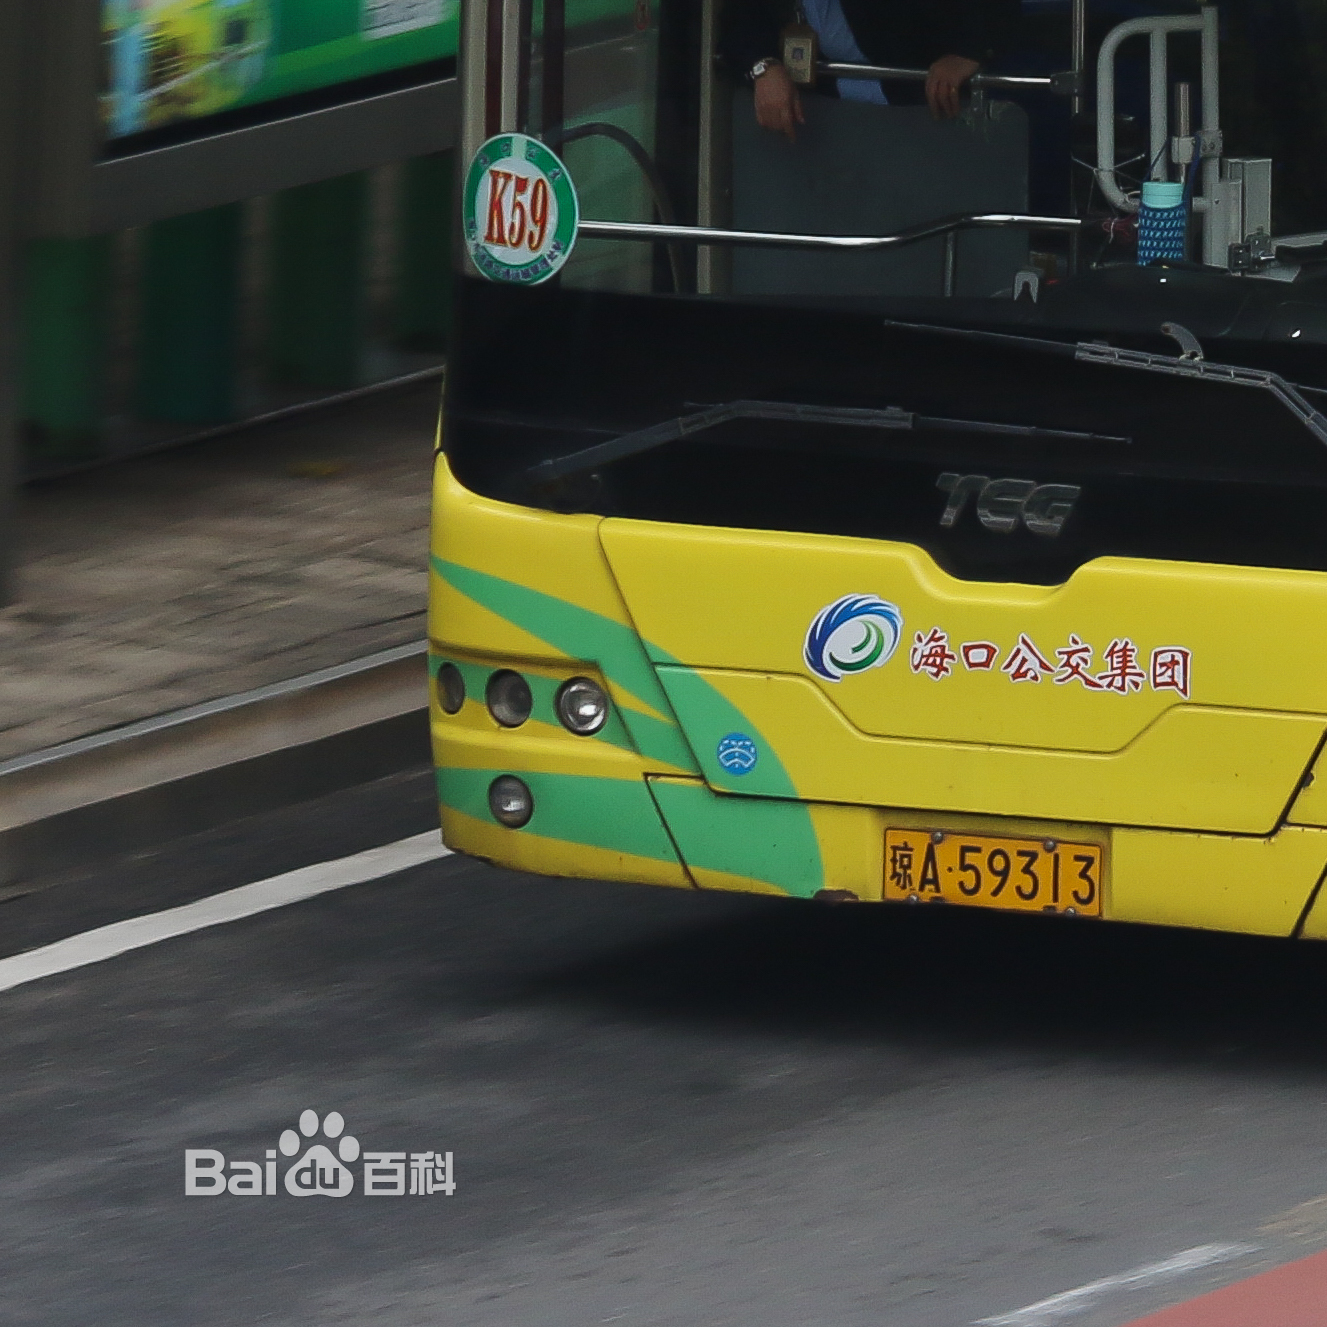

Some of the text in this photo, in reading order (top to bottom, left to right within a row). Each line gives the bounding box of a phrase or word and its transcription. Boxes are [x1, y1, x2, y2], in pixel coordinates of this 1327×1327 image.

[484, 169, 549, 252] K59
[911, 627, 1190, 699] 海口公交集团
